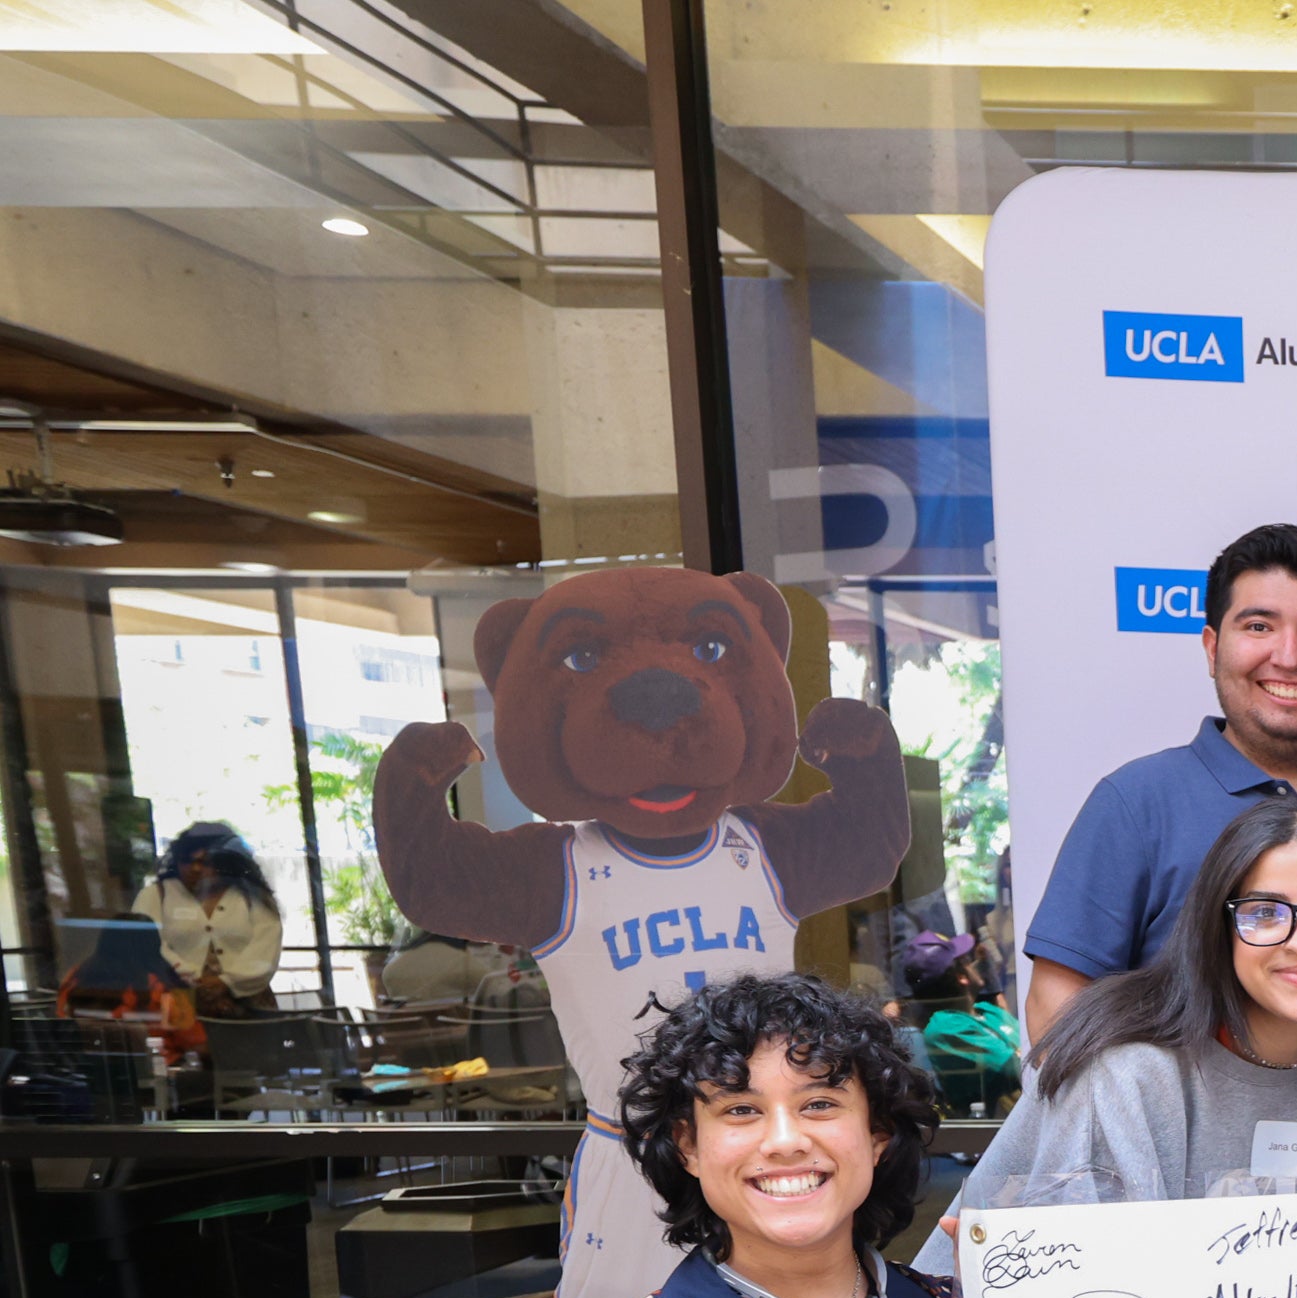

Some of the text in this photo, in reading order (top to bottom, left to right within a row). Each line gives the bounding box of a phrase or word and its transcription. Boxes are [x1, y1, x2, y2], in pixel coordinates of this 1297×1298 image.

[1124, 328, 1225, 367] UCLA
[1136, 585, 1206, 619] UCL
[601, 905, 767, 972] UCLA
